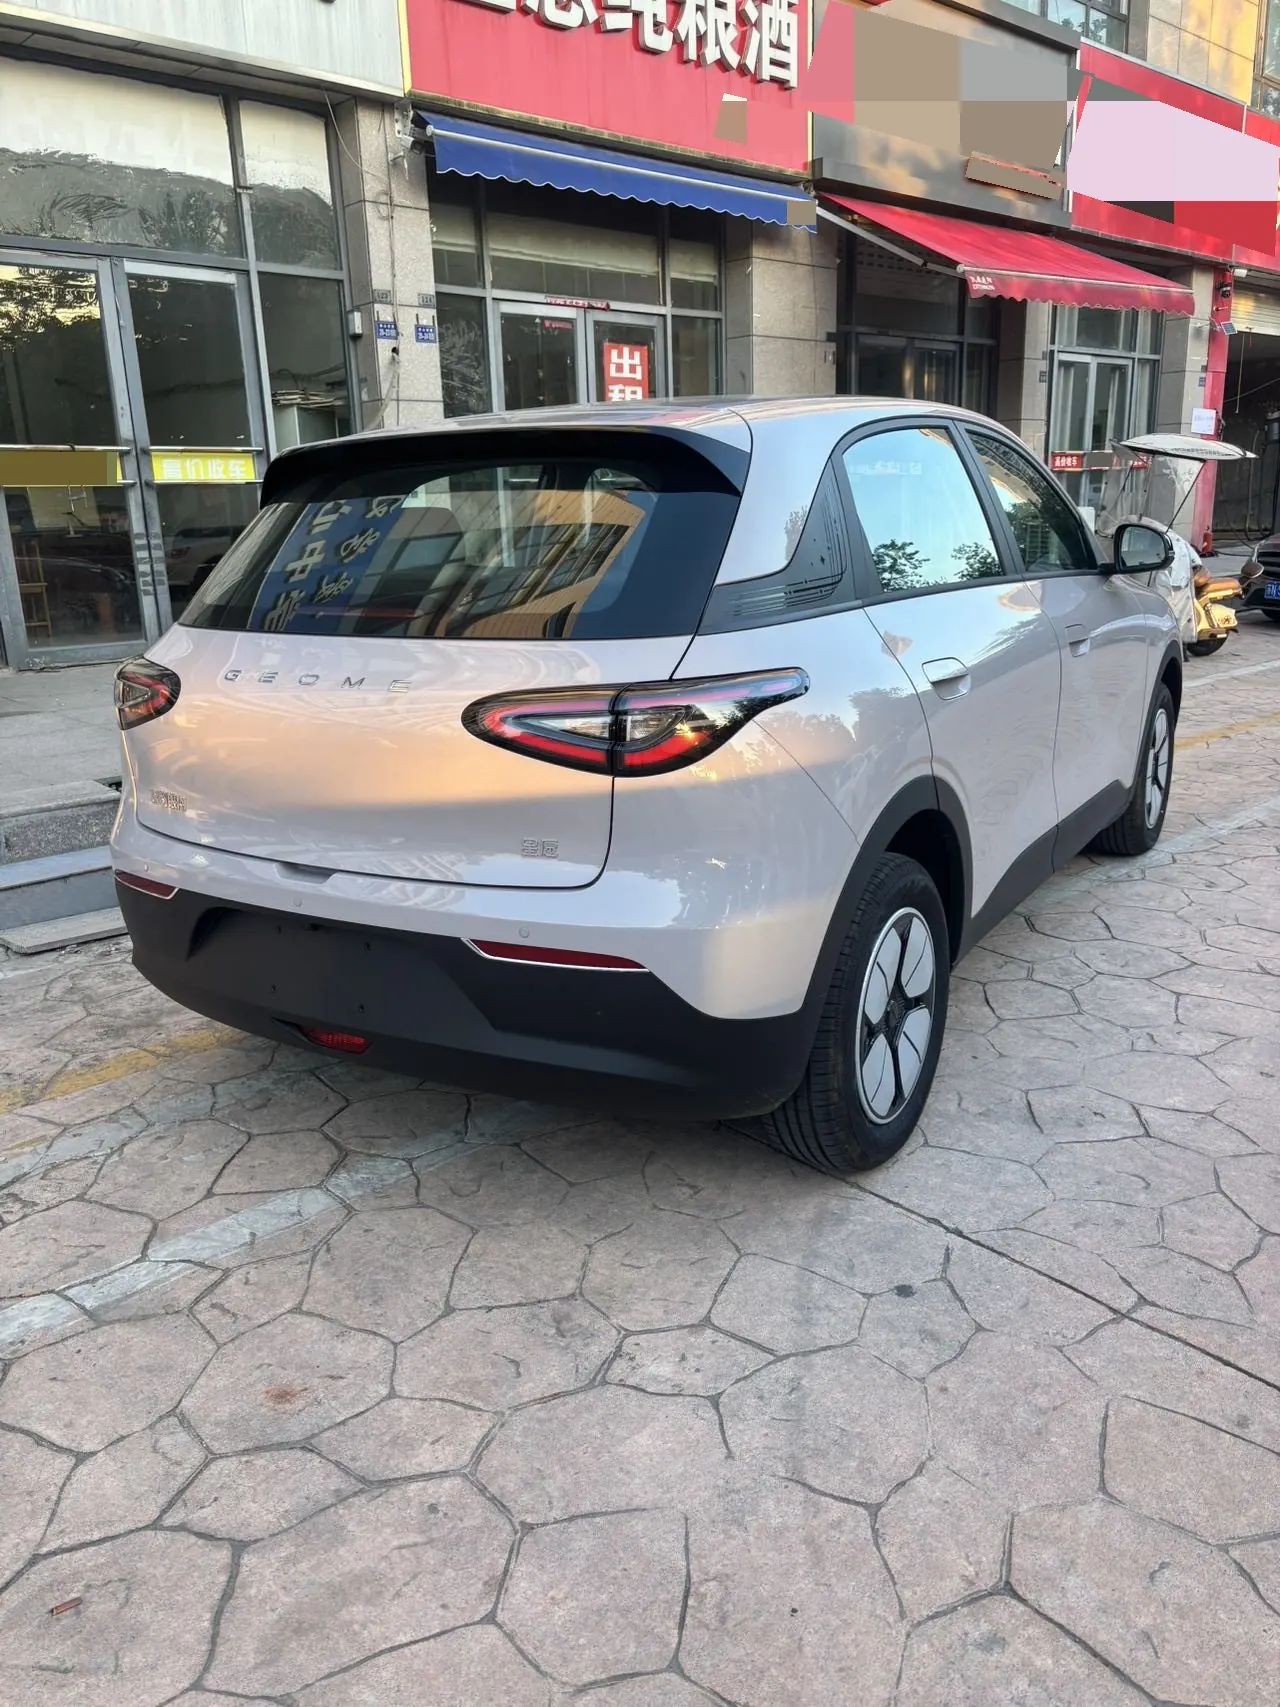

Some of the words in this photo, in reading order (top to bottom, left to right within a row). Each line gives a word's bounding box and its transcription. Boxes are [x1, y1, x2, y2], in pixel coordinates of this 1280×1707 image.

[450, 0, 799, 89] 纯粮酒
[223, 669, 412, 693] GEOME
